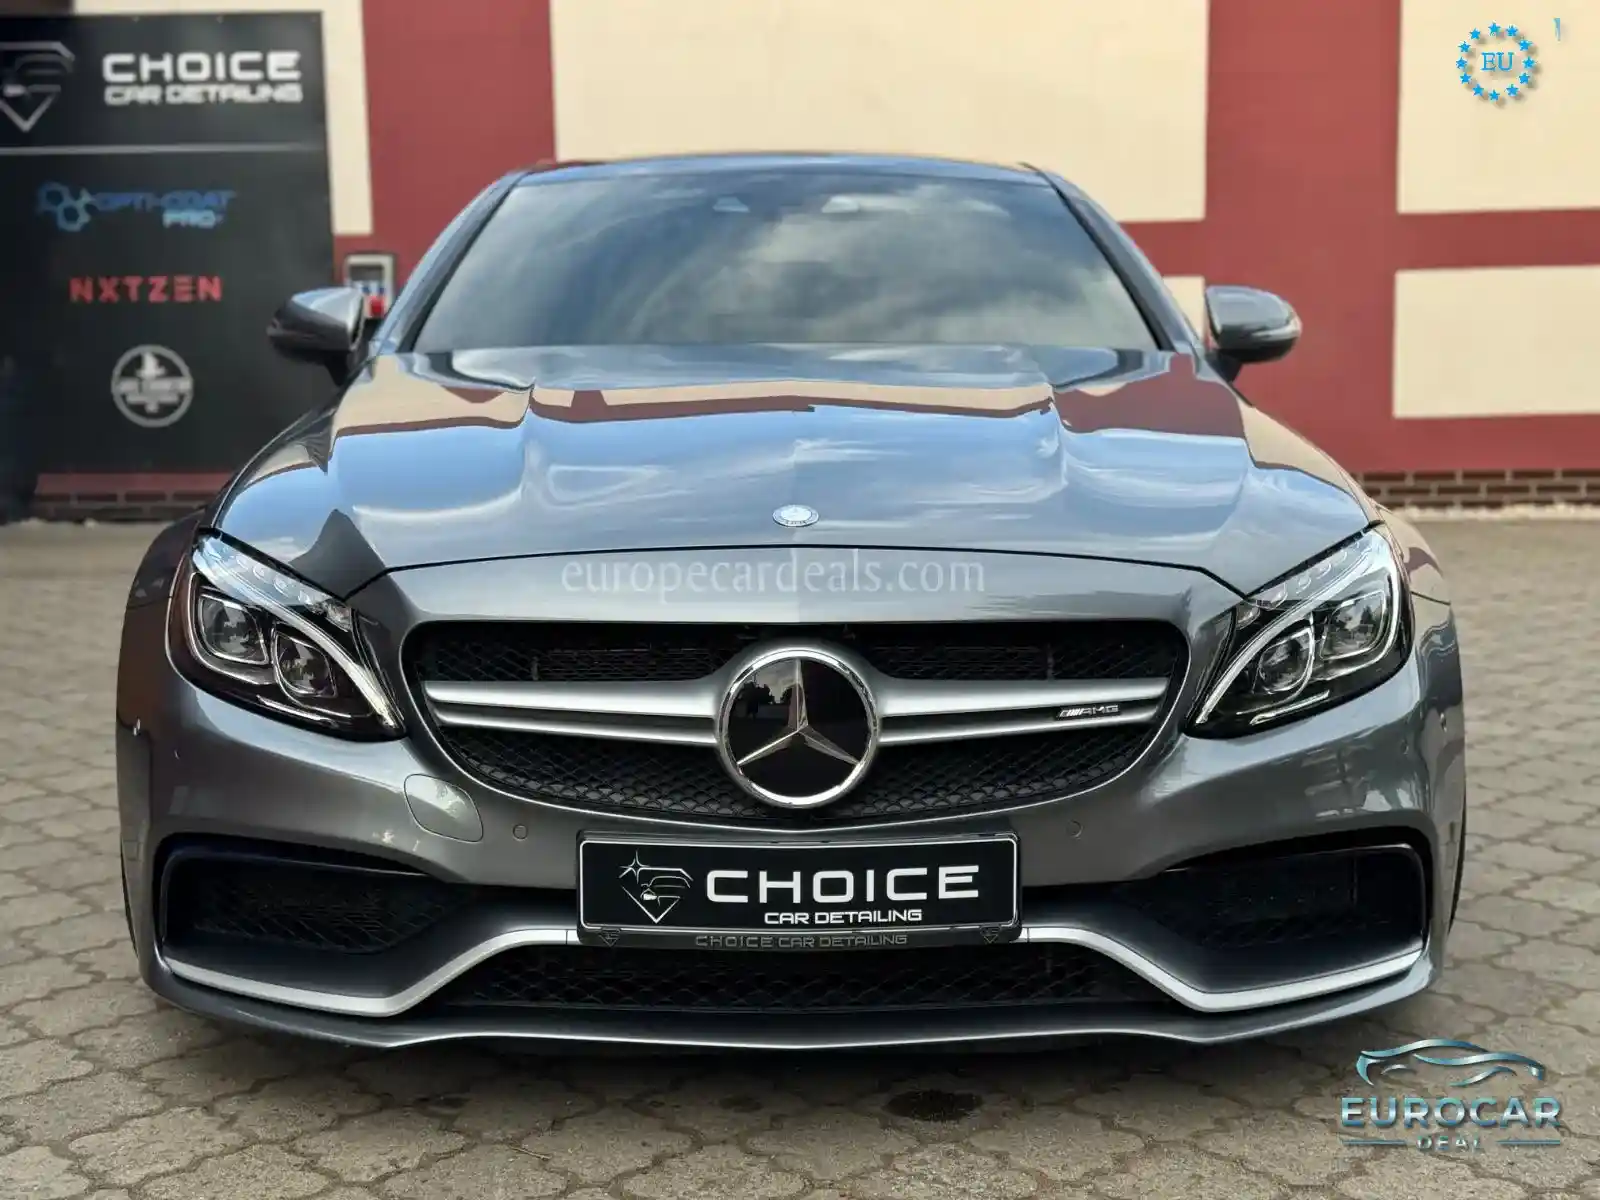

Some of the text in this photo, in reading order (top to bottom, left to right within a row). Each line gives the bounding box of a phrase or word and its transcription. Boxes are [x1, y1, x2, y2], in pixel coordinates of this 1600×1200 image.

[102, 50, 302, 82] CHOICE
[104, 86, 162, 106] CAR
[69, 275, 223, 303] NXTZEN
[706, 865, 979, 904] CHOICE
[764, 908, 922, 925] CAR DETAILING
[695, 934, 908, 948] CHOICE CAR DETAILING
